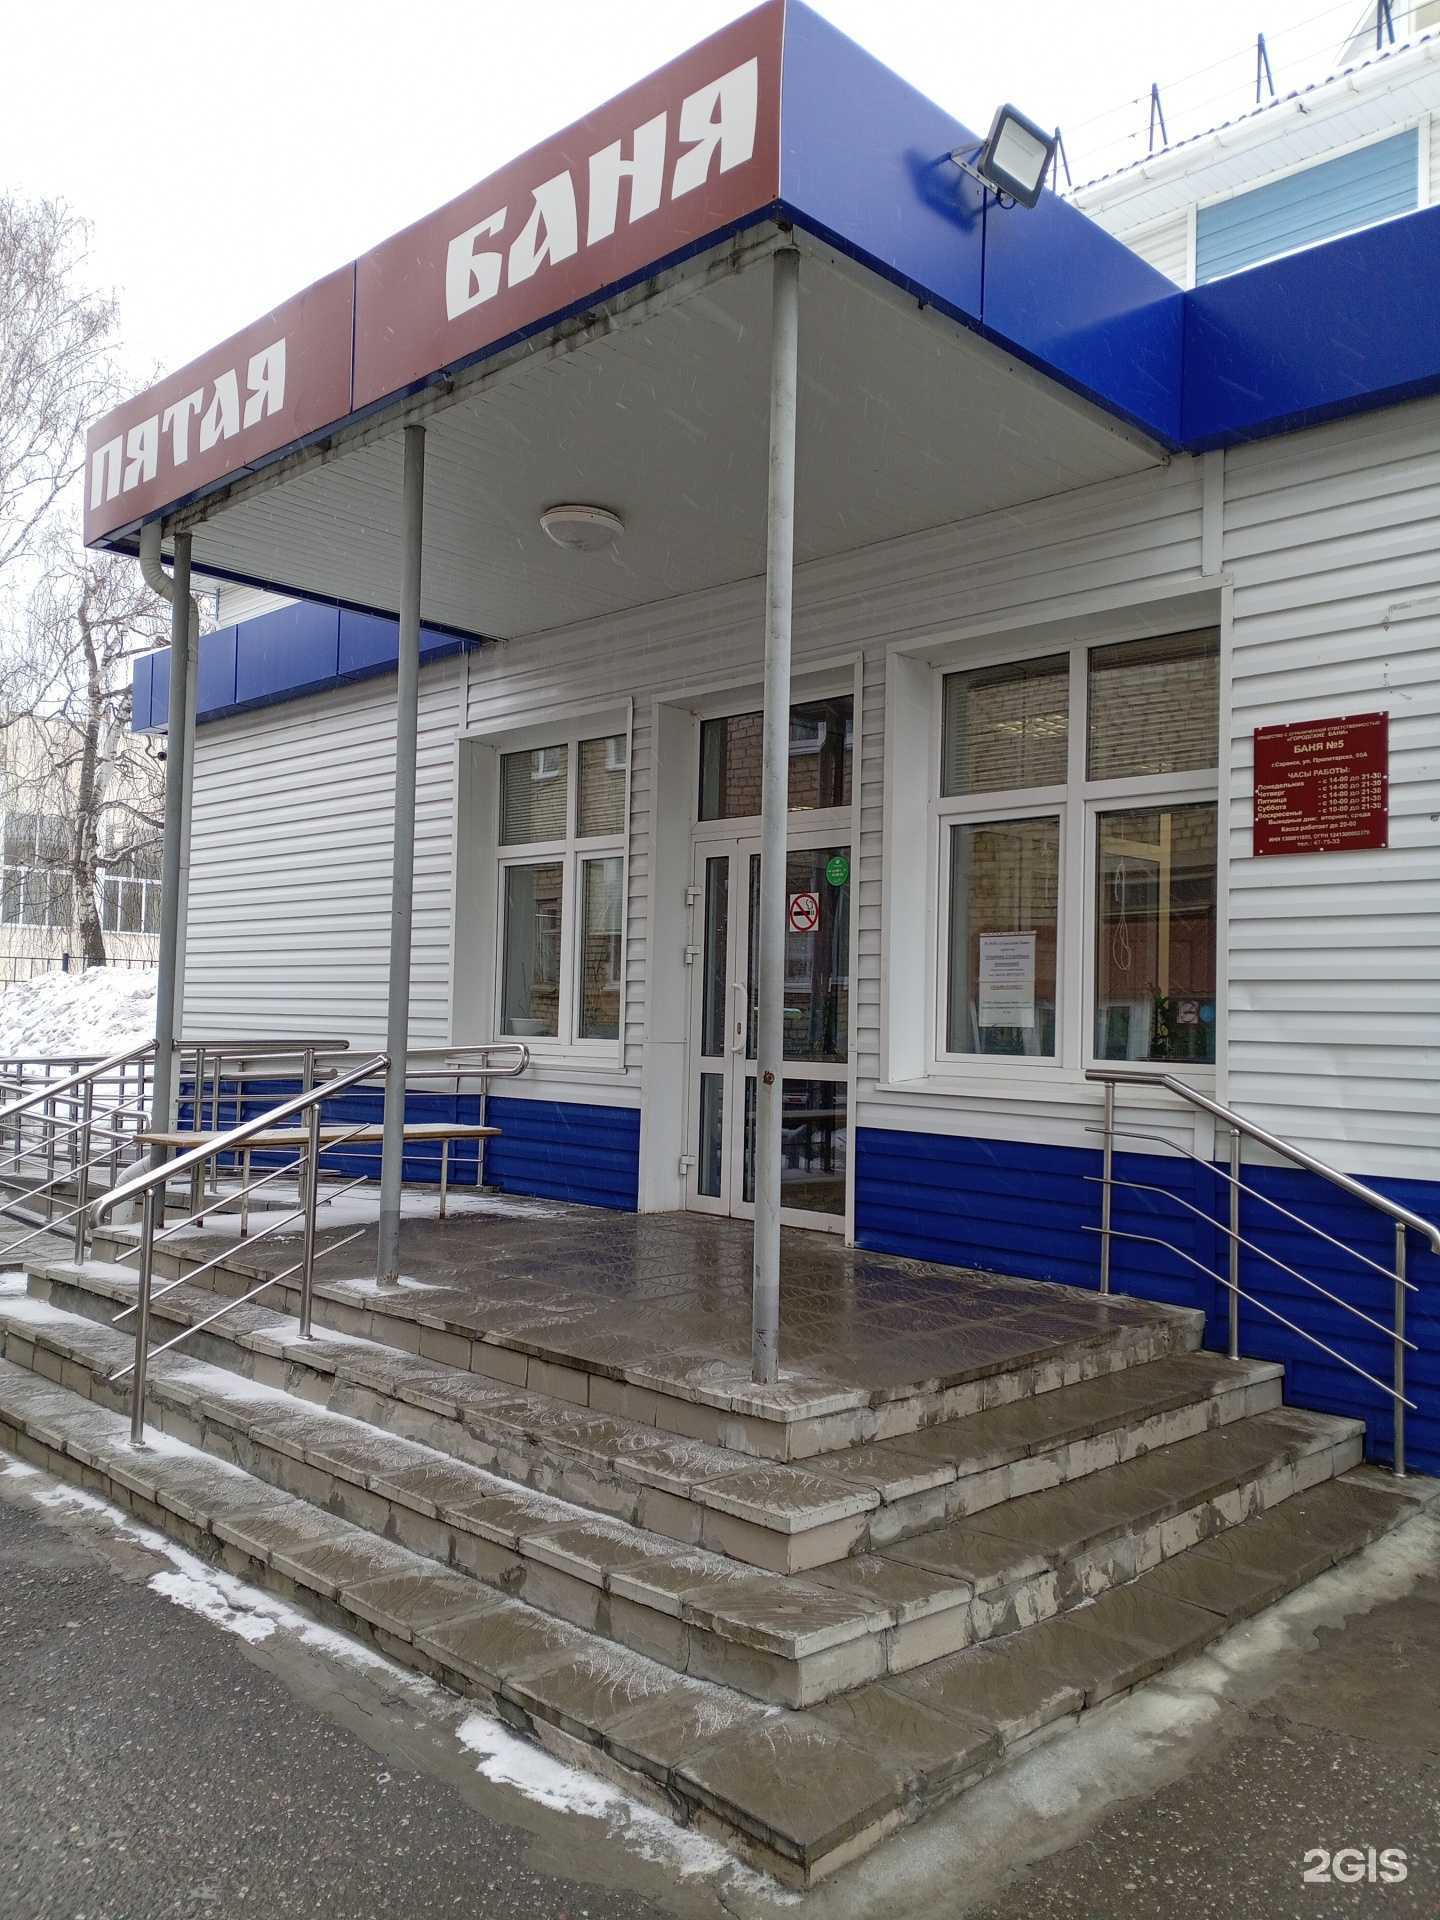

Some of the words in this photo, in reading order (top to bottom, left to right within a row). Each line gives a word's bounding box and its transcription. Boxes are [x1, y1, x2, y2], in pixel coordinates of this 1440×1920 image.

[90, 337, 286, 511] ПЯТАЯ
[446, 56, 758, 320] БАНЯ
[1294, 742, 1323, 753] БАНЯ
[1326, 739, 1344, 749] №5
[1287, 770, 1311, 778] ЧАСЫ
[1313, 765, 1350, 776] РАБОТЫ:
[1257, 781, 1304, 791] Понедельник
[1257, 790, 1284, 798] Четверг
[1257, 797, 1286, 805] Пятница
[1257, 804, 1286, 812] Суббота
